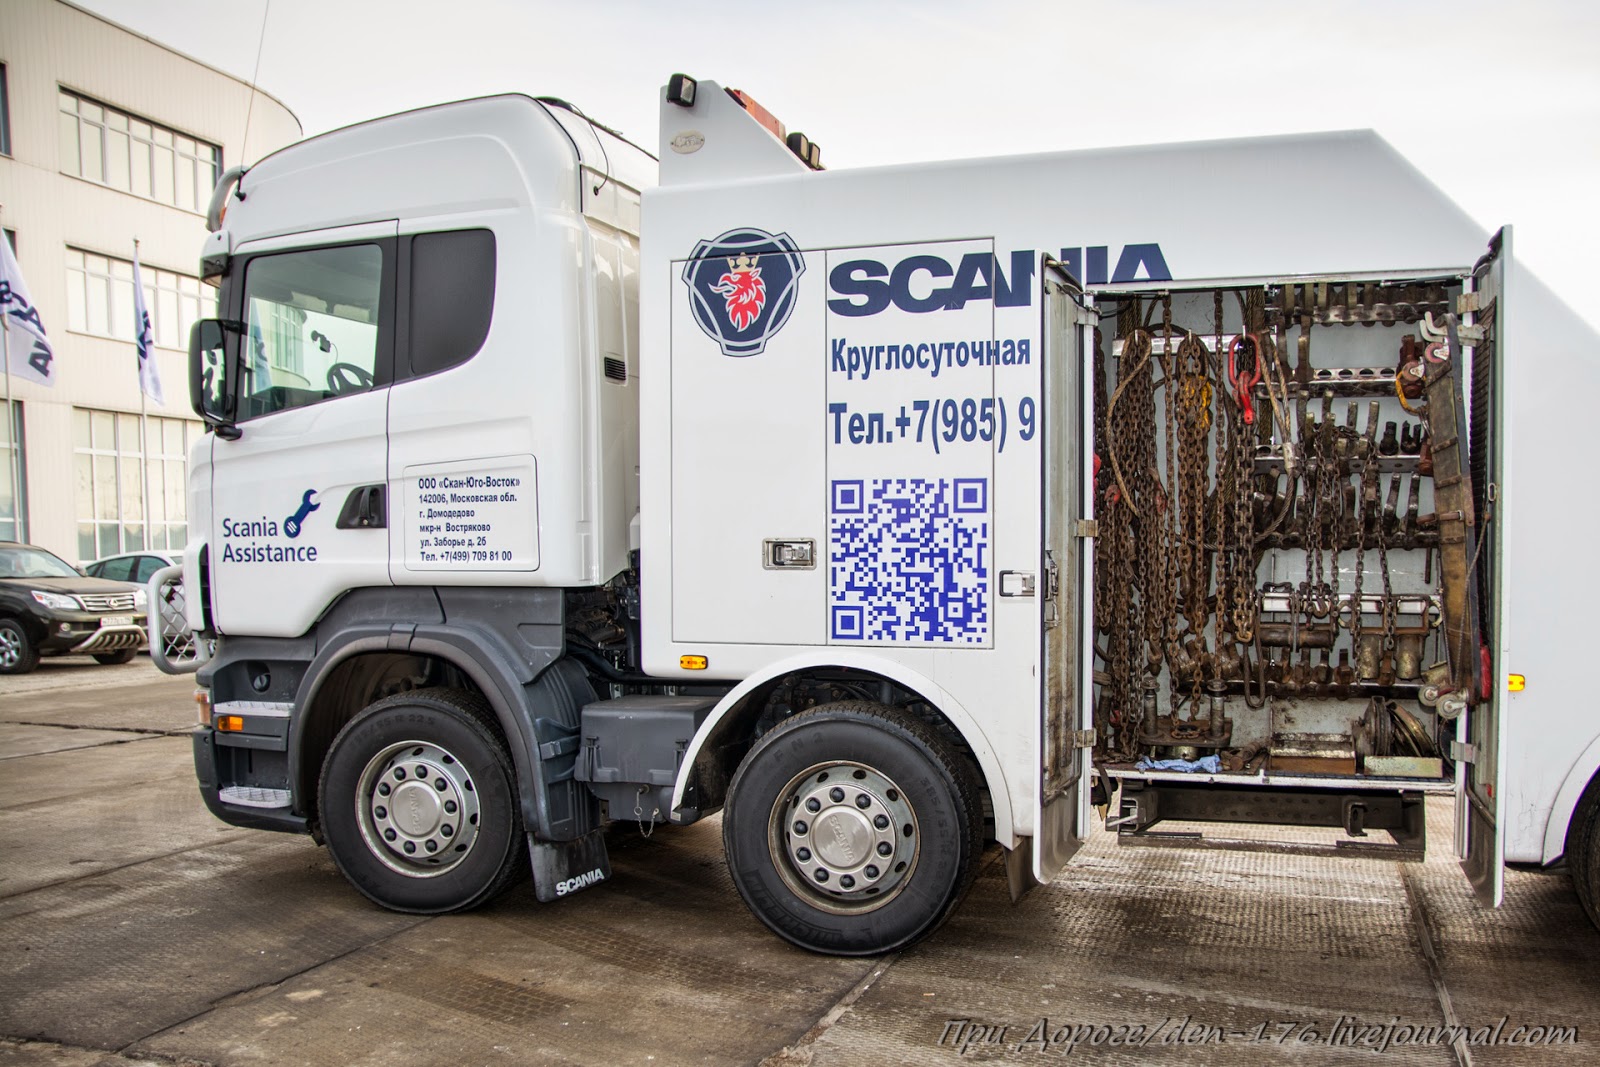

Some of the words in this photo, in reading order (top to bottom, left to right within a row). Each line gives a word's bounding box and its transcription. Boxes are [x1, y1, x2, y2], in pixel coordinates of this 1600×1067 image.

[831, 337, 1031, 380] Круглосуточная
[828, 396, 1007, 455] Тел.+7(985)
[1018, 396, 1036, 441] 9
[418, 478, 436, 489] ООО
[439, 476, 520, 489] «Скан-Юго-Восток»
[419, 493, 448, 505] 142006,
[450, 493, 498, 503] Московская
[500, 492, 517, 502] обл.
[419, 510, 425, 518] г.
[427, 508, 475, 519] Домодедово
[222, 516, 278, 537] Scania
[420, 525, 441, 534] мкр-н
[446, 522, 491, 534] Востряково
[420, 539, 431, 549] ул.
[434, 537, 465, 548] Заборье
[467, 539, 475, 548] д.
[222, 542, 317, 562] Assistance
[420, 552, 438, 561] Тел.
[440, 551, 470, 563] +7(499)
[472, 551, 487, 561] 709
[489, 551, 499, 561] 81
[502, 551, 512, 561] 00
[556, 868, 604, 896] SCANIA
